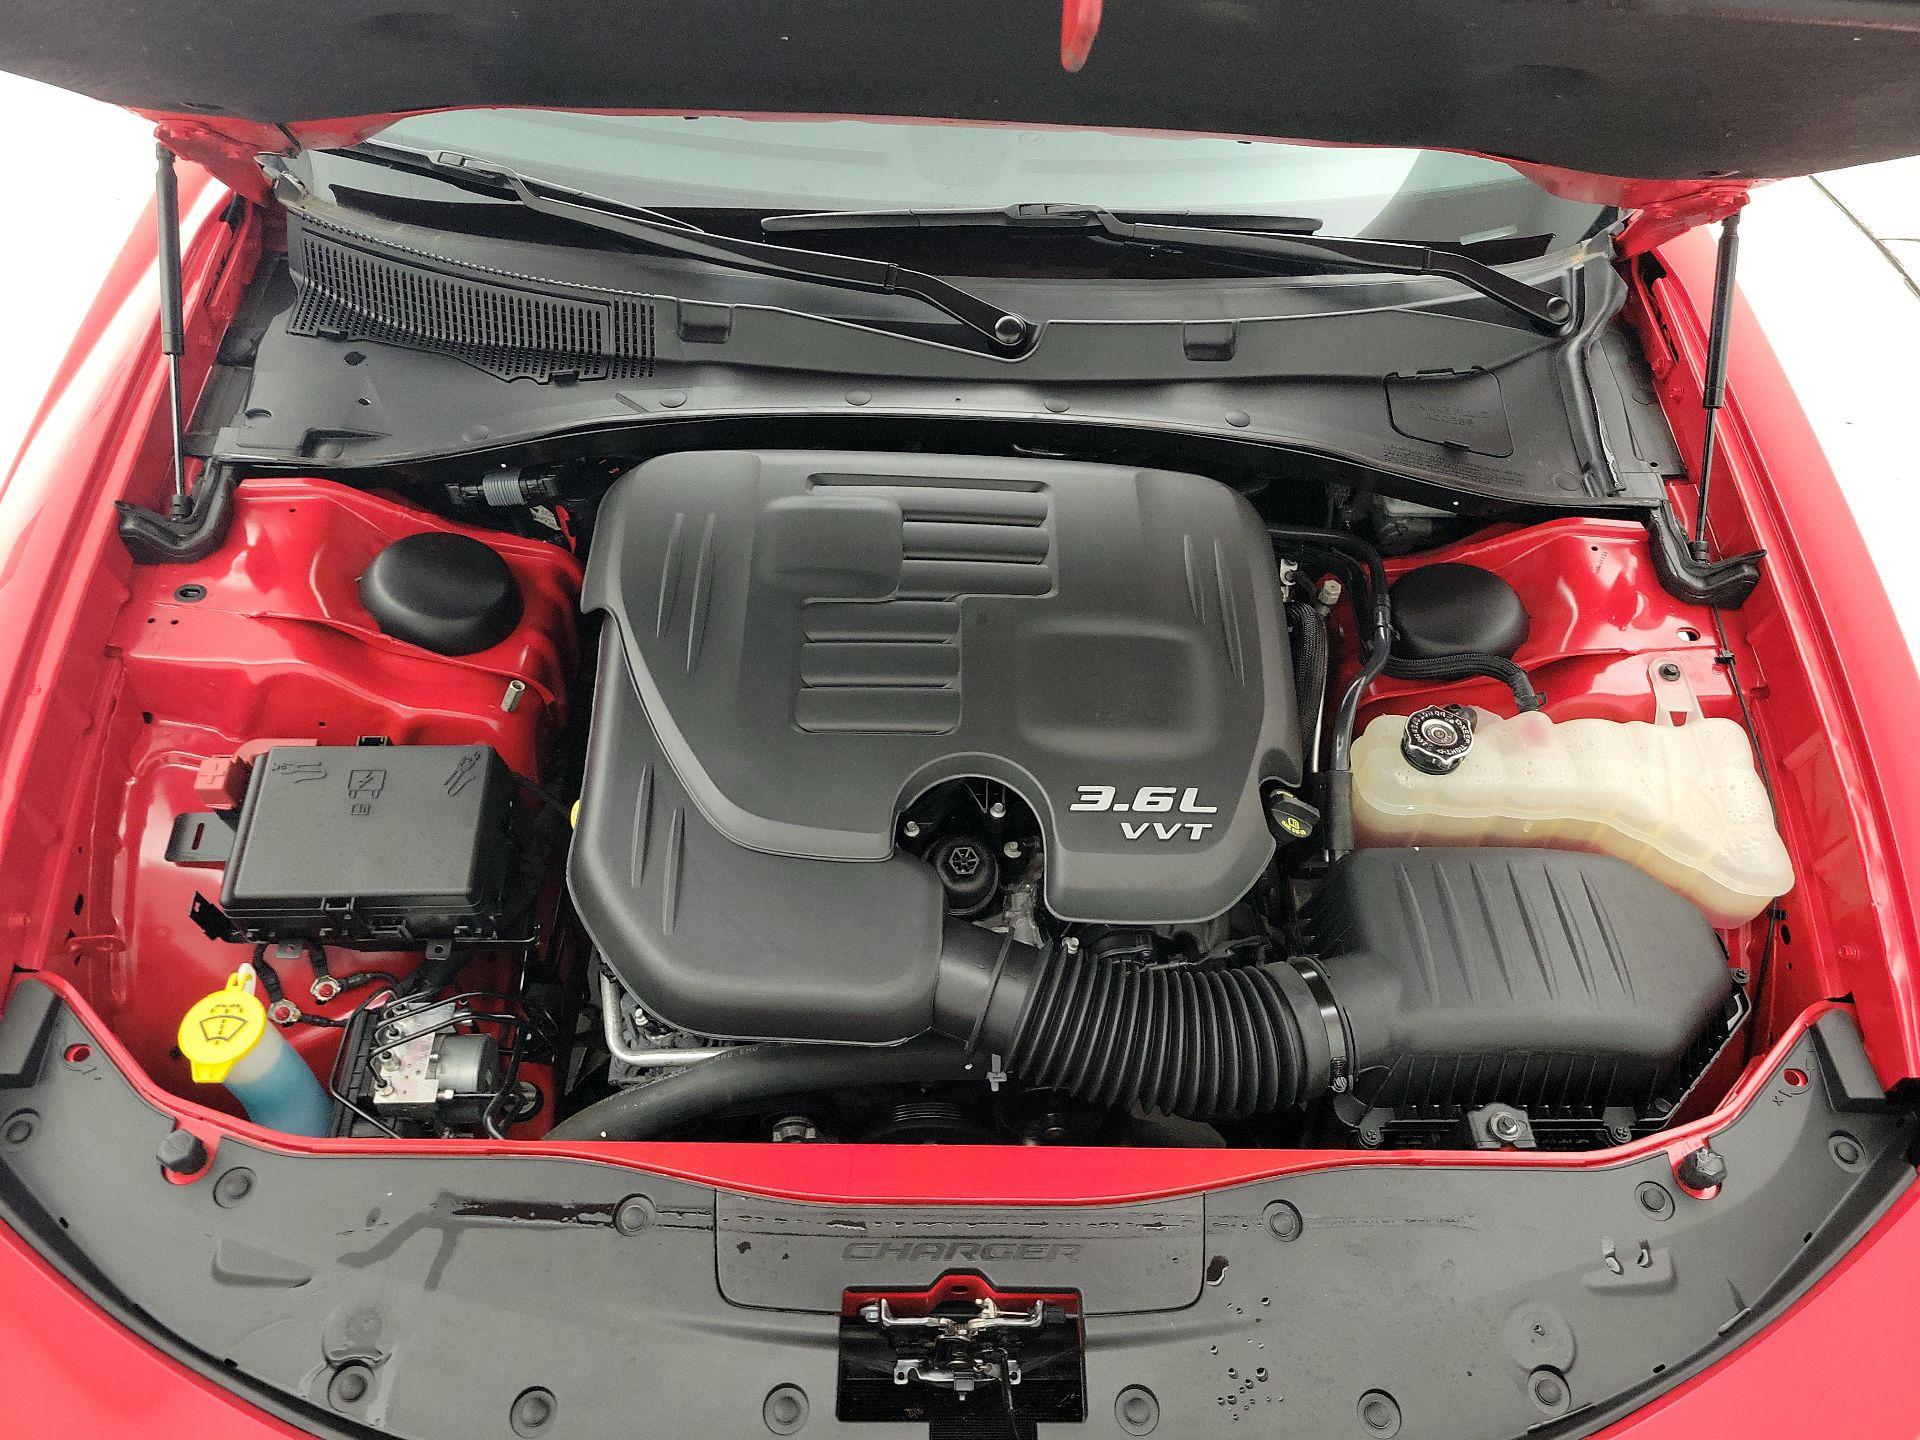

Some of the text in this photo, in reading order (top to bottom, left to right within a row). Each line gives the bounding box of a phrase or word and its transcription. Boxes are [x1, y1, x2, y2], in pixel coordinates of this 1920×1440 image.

[1069, 785, 1218, 814] 3.6L
[1120, 822, 1213, 841] VVT
[841, 1241, 1084, 1263] CHARGER
